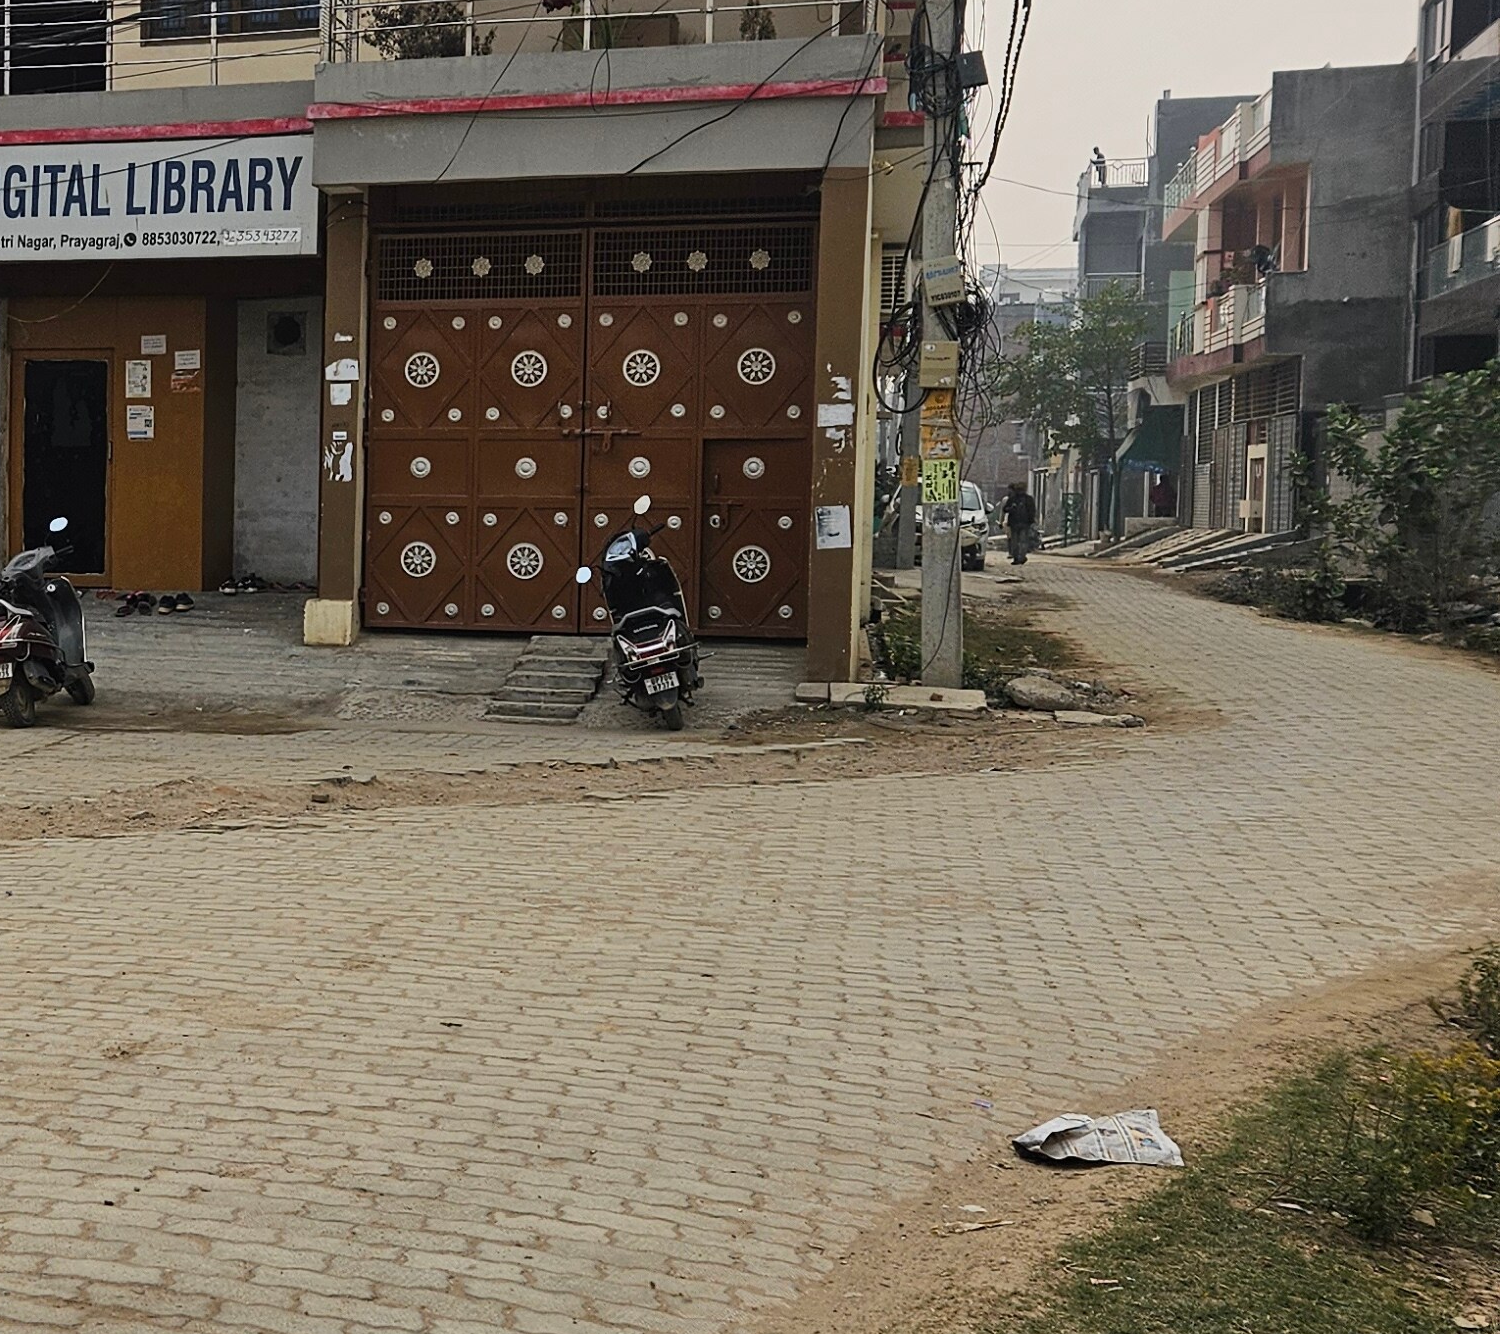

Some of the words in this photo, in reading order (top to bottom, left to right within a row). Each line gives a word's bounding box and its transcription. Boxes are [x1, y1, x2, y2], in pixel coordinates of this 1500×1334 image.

[126, 156, 303, 215] LIBRARY
[17, 234, 56, 251] Nagar,
[60, 233, 123, 250] Prayagraj,
[142, 231, 220, 246] 8853030722,
